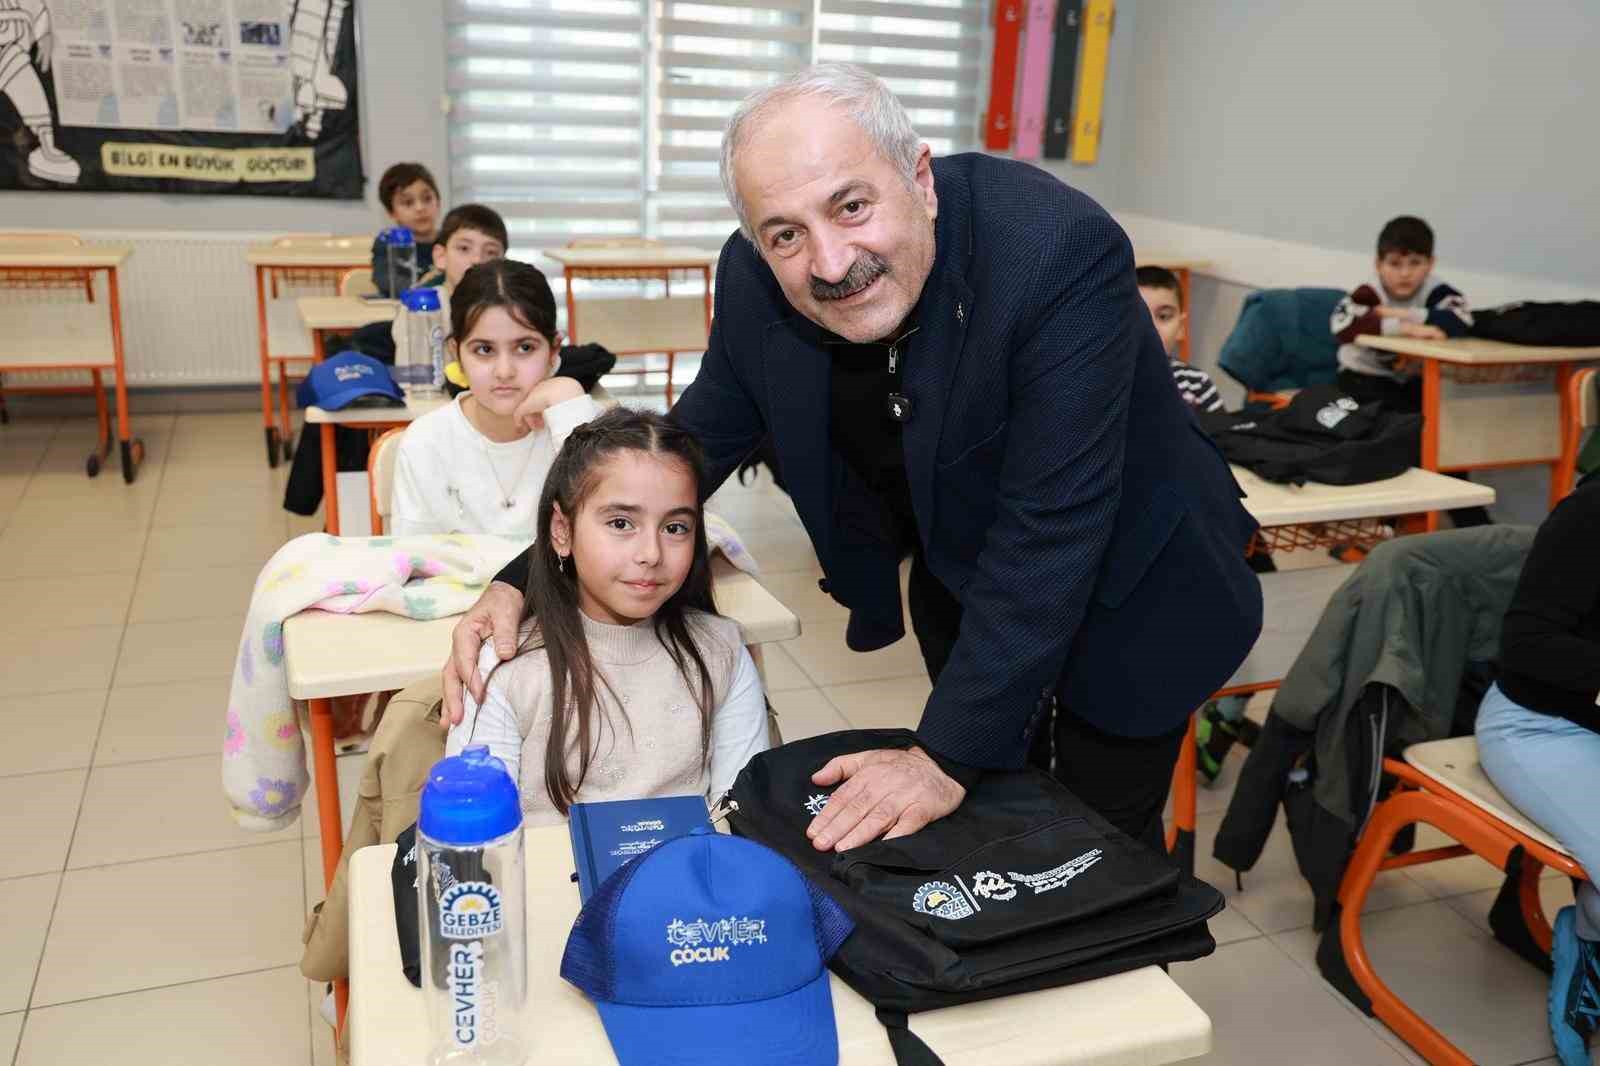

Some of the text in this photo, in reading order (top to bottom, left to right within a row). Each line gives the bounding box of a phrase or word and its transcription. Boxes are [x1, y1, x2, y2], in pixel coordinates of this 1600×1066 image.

[158, 153, 179, 167] EN
[443, 907, 501, 927] GEBZE
[667, 917, 767, 946] CEVHER
[454, 949, 476, 1045] CEVHER
